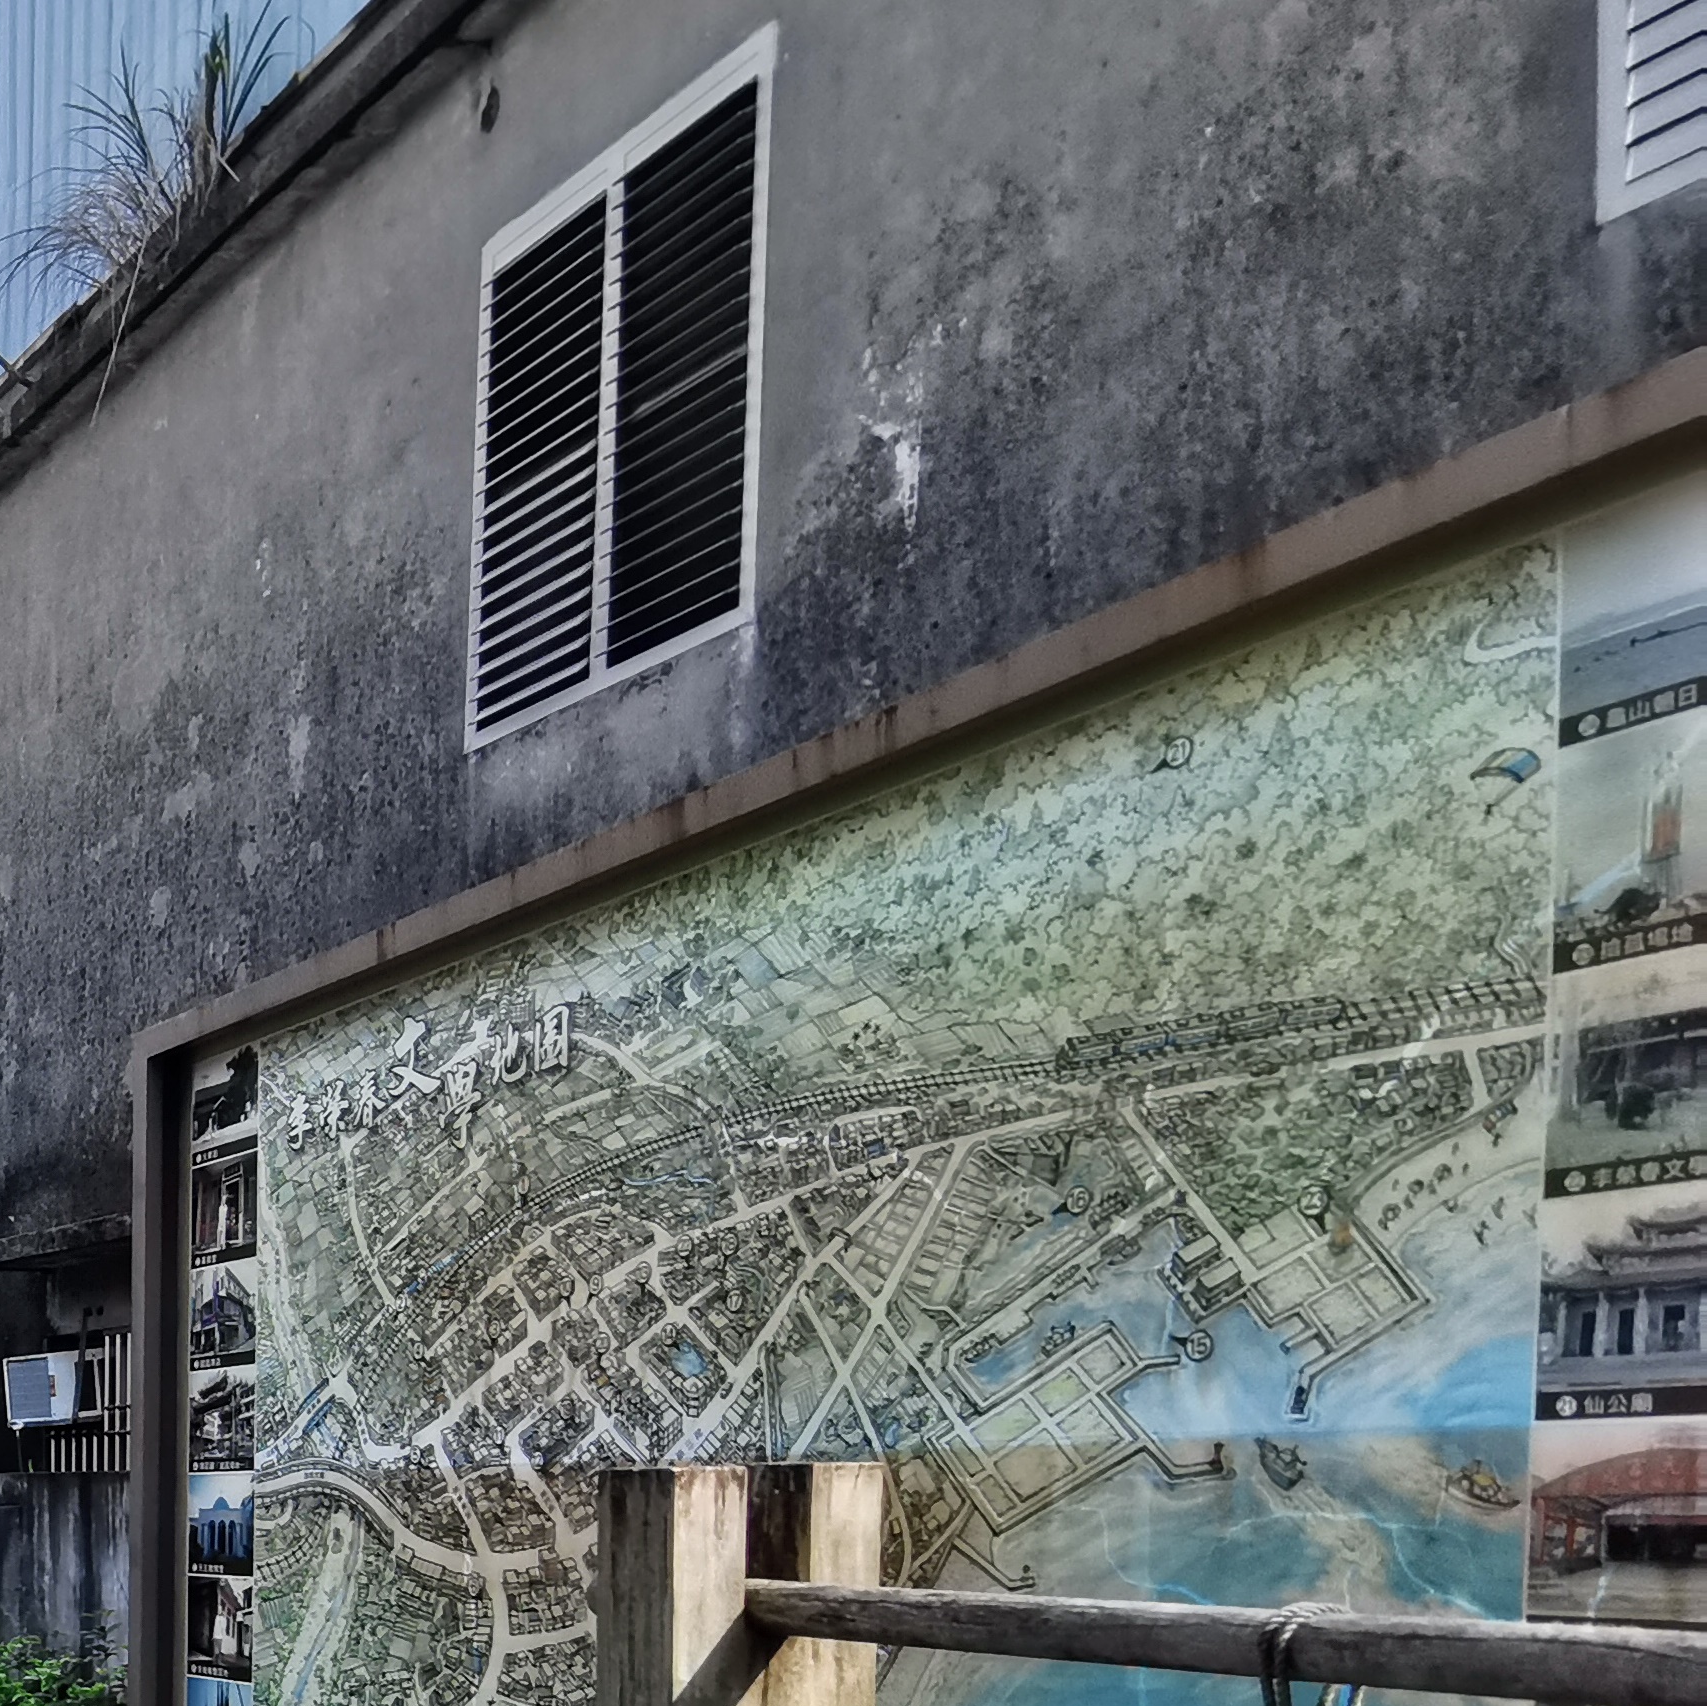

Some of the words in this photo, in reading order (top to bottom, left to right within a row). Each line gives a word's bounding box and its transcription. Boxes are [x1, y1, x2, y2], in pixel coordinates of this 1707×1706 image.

[285, 1005, 571, 1150] 李榮春文學地圖
[1583, 1393, 1654, 1414] 仙公廟
